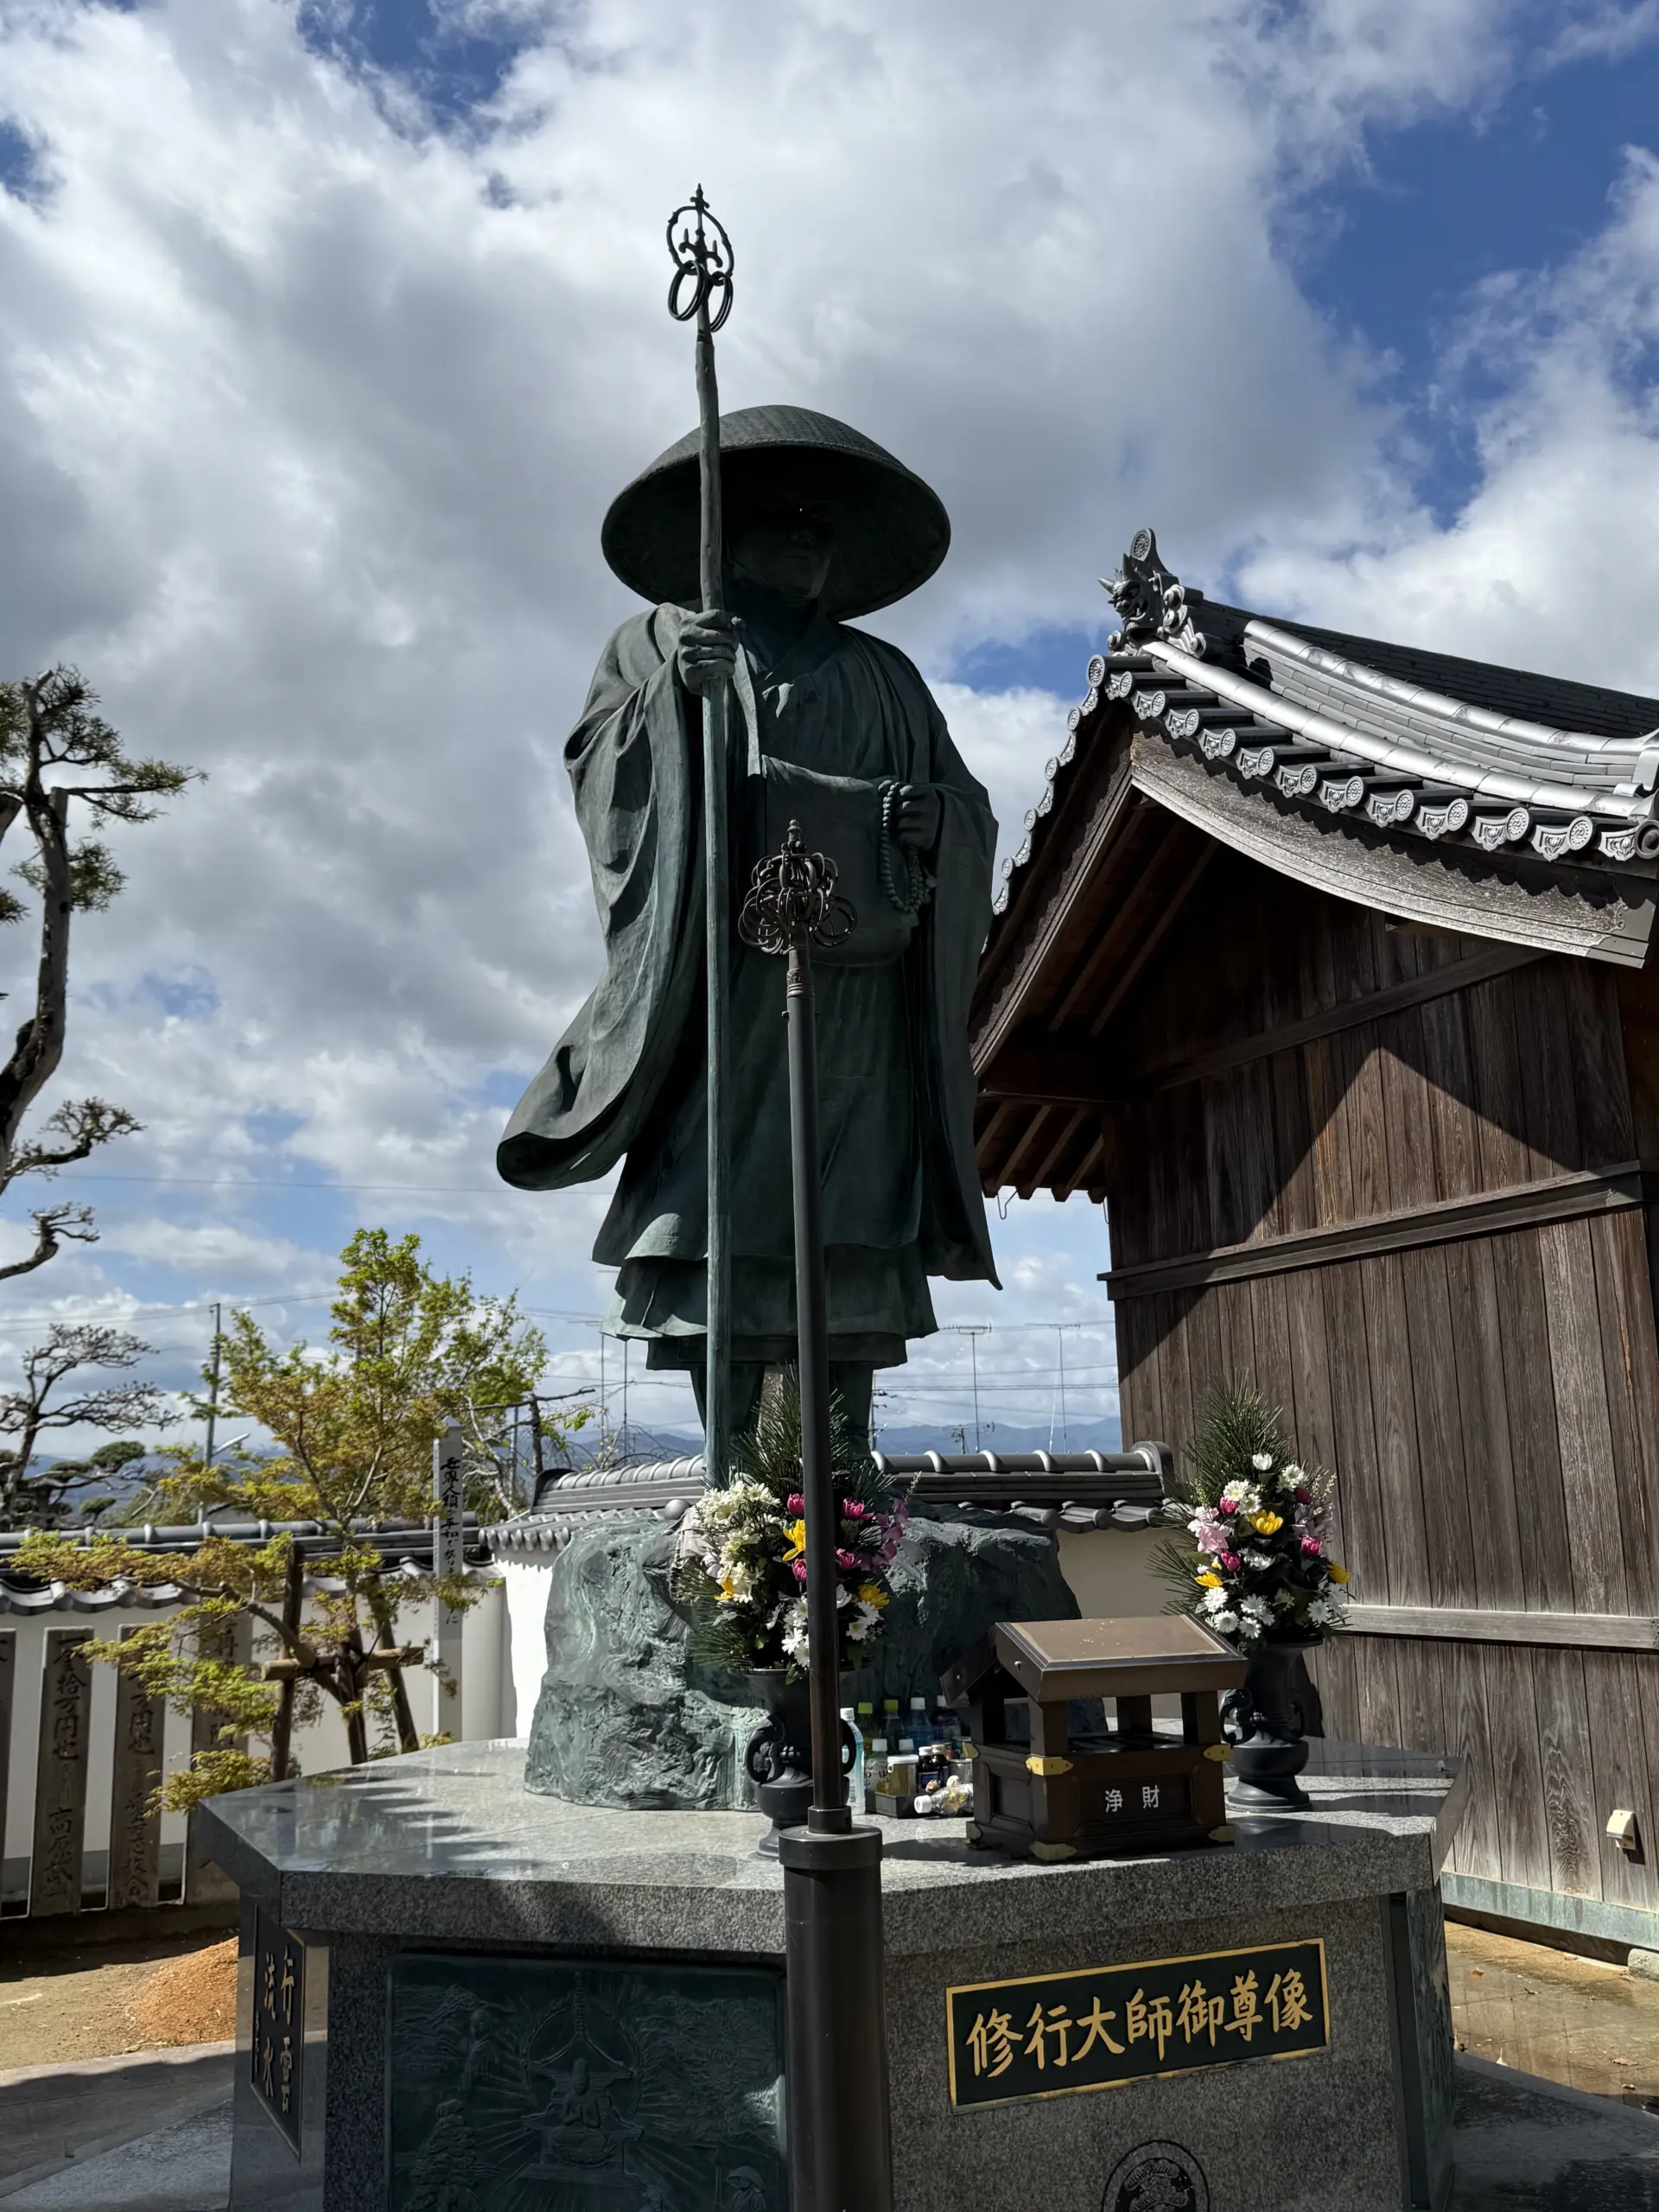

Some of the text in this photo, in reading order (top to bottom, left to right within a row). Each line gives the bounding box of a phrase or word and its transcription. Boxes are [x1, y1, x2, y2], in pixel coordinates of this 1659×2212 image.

[1105, 1784, 1160, 1813] 浄財
[965, 1968, 1313, 2078] 修行大師御尊像
